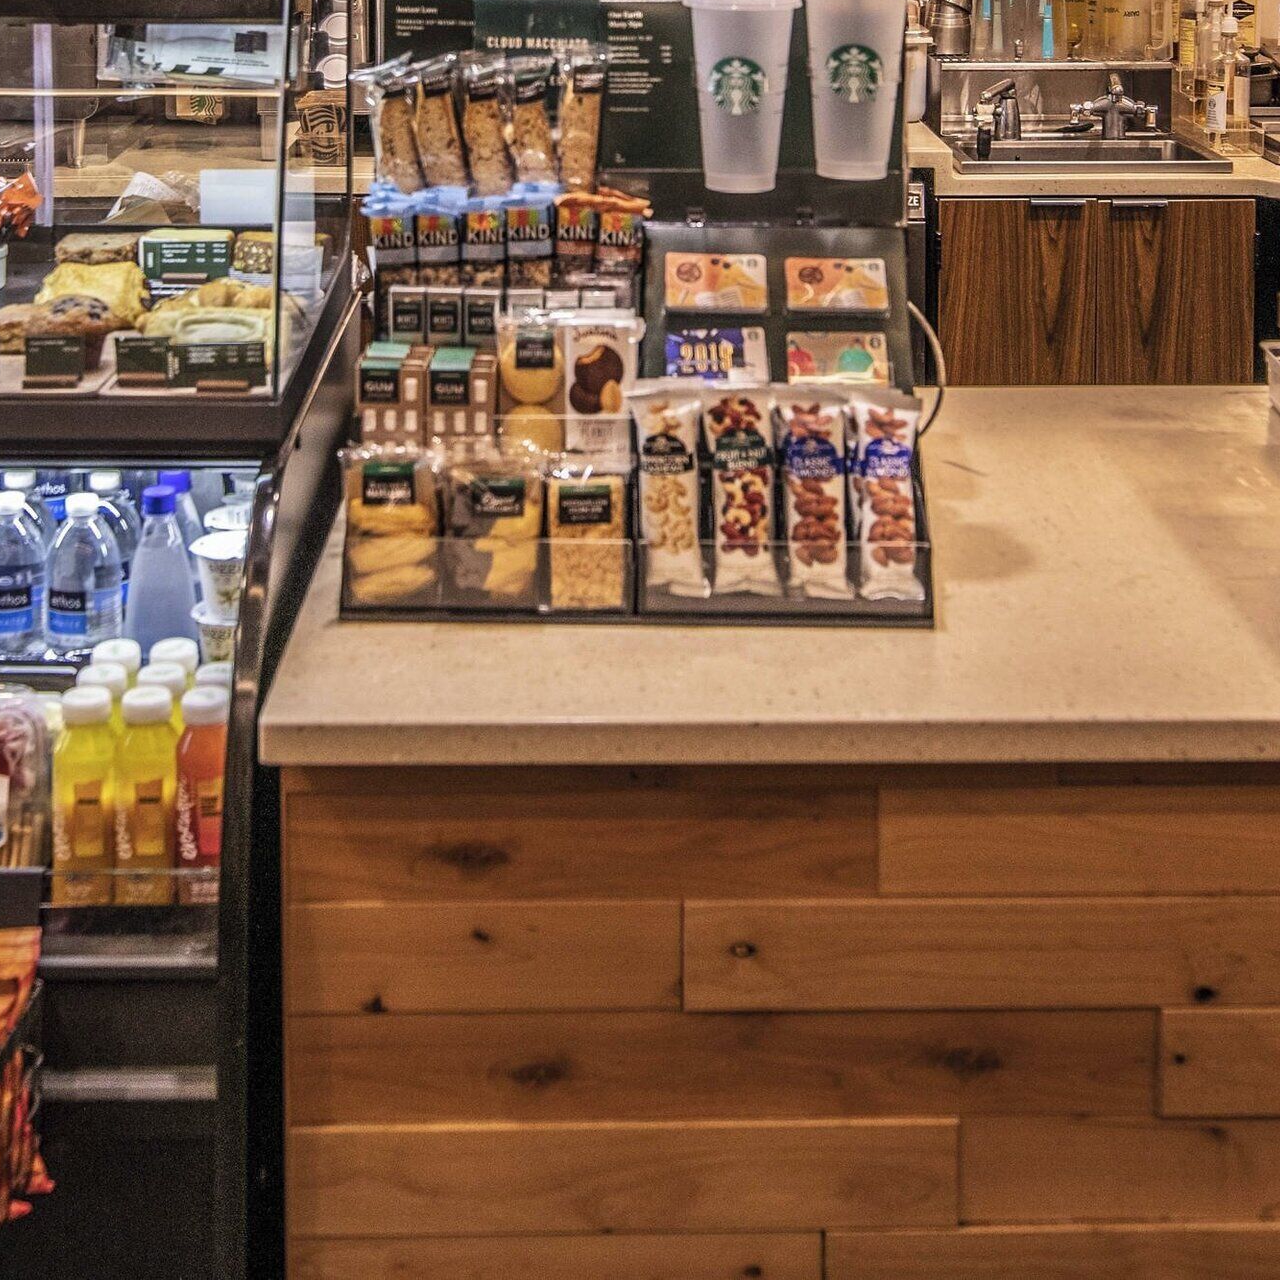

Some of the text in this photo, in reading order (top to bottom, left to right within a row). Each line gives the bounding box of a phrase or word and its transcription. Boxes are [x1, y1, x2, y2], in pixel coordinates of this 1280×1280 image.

[486, 36, 522, 48] CLOUD
[372, 232, 415, 248] KIND
[418, 230, 458, 246] KIND
[508, 224, 549, 242] KIND
[680, 340, 734, 373] 2019
[364, 380, 395, 393] GUM
[434, 382, 464, 394] GUM
[52, 596, 81, 609] ethos
